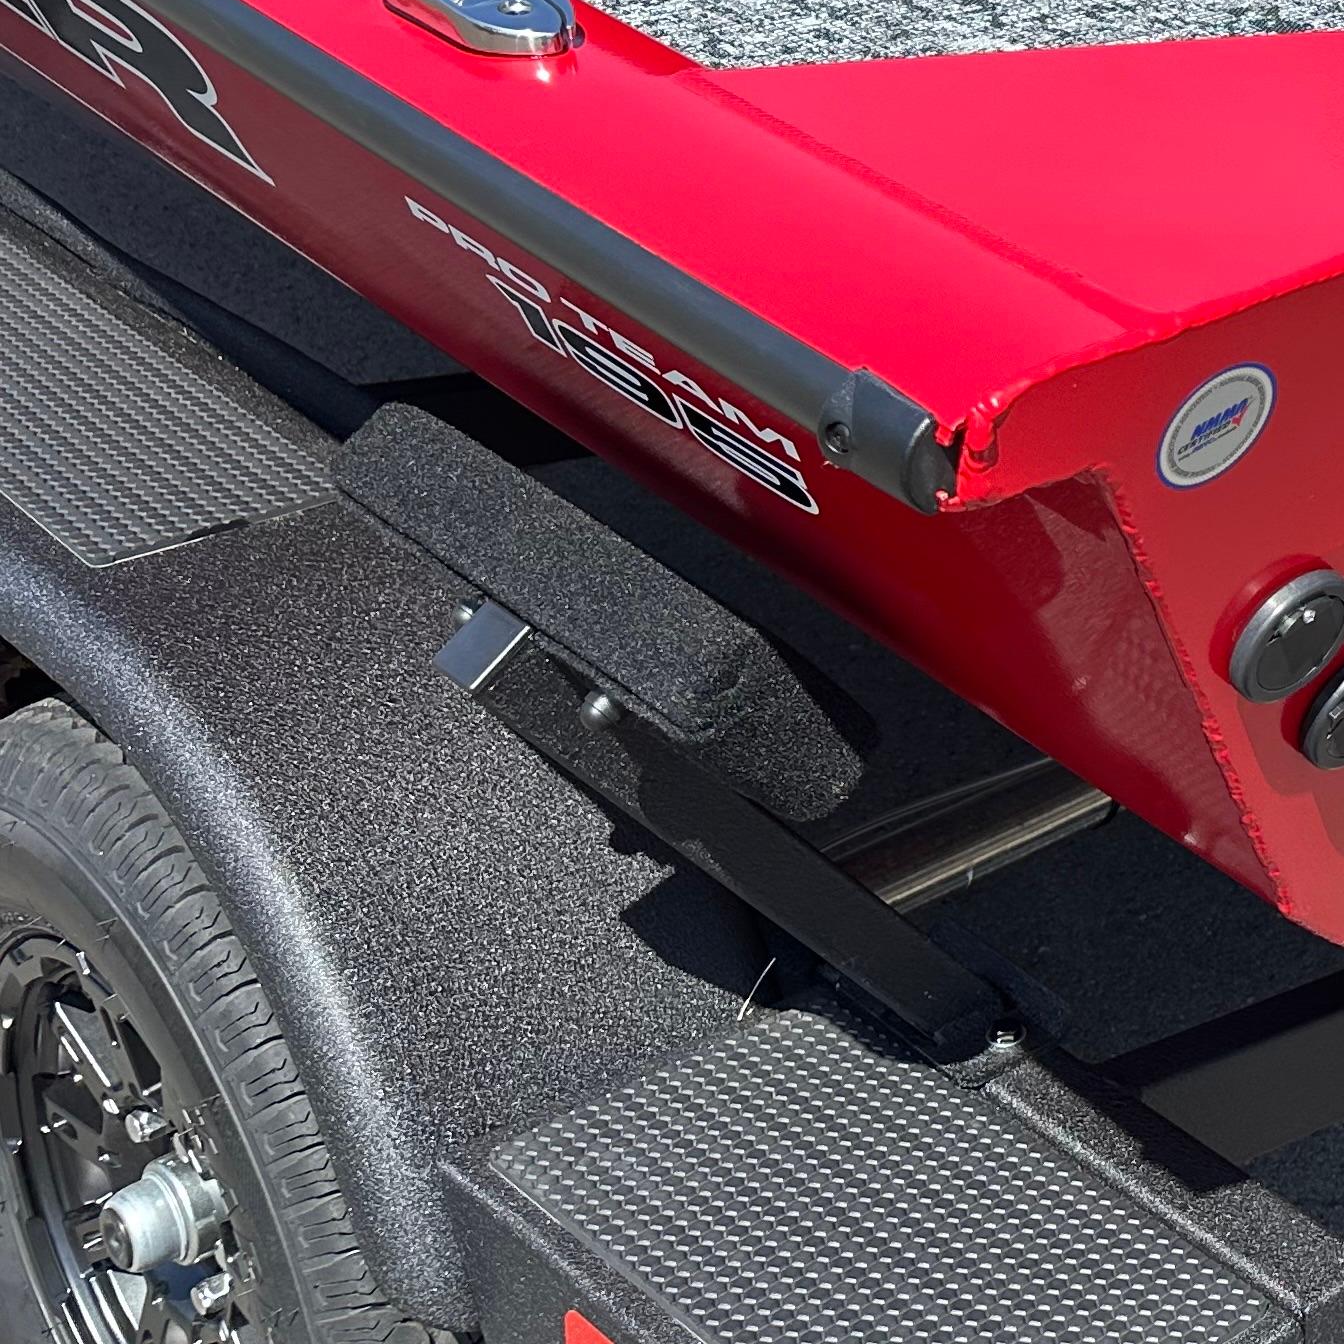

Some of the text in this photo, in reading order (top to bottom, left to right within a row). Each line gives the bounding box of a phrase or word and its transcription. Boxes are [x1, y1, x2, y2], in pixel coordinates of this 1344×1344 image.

[404, 195, 802, 462] PRO TEAM
[485, 273, 820, 515] 195
